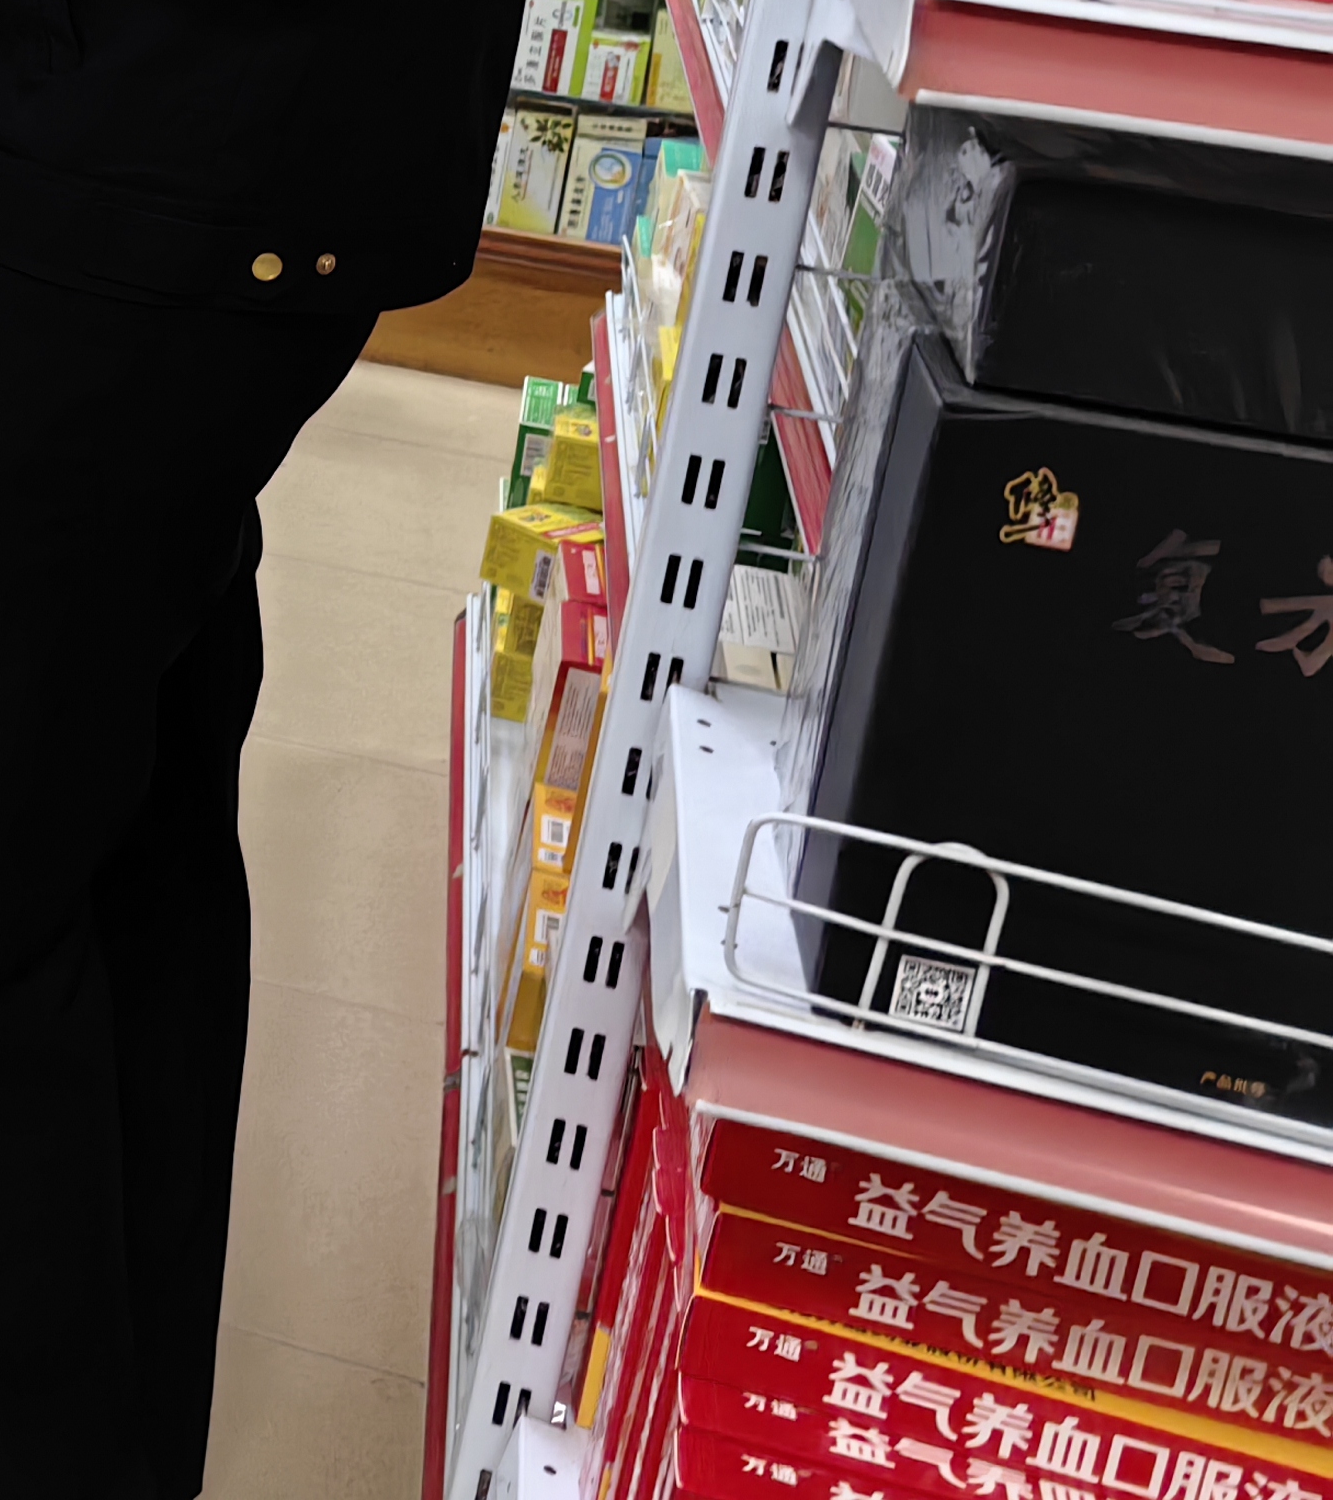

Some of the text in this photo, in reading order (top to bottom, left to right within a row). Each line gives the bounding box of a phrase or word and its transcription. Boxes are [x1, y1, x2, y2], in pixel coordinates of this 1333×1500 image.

[746, 1325, 803, 1364] 万通
[772, 1242, 829, 1278] 万通
[846, 1262, 1333, 1439] 益气养血口服液
[773, 1147, 828, 1185] 万通
[846, 1171, 1333, 1358] 益气养血口服液
